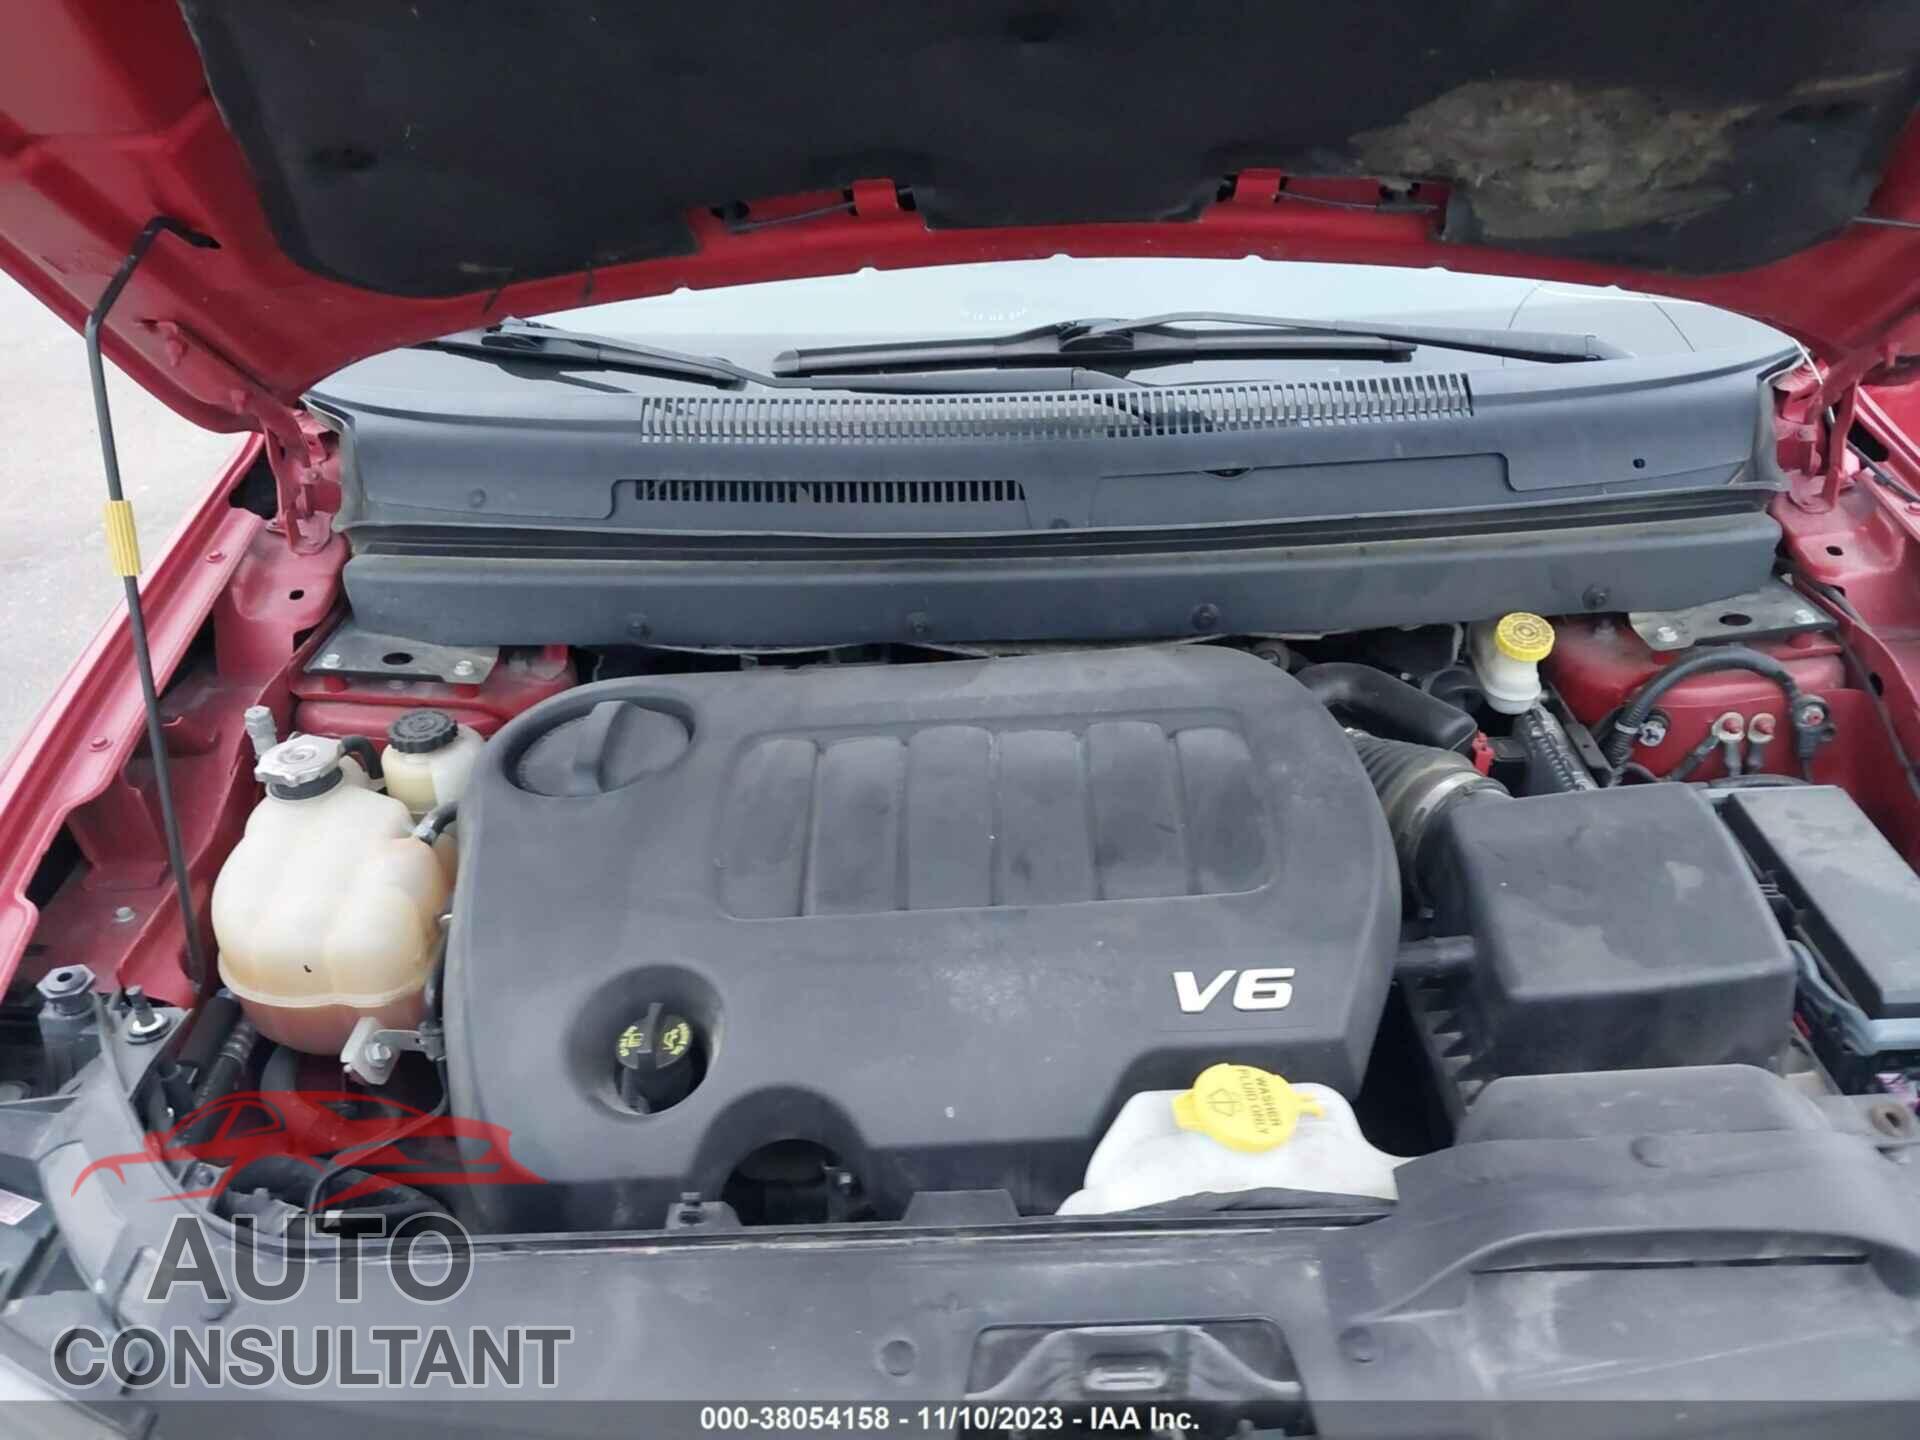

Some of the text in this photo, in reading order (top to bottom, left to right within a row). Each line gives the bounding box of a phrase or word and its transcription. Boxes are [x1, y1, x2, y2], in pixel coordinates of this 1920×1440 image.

[1173, 967, 1296, 1012] V6
[1249, 1104, 1270, 1134] ONLY
[1254, 1077, 1281, 1126] WASHER
